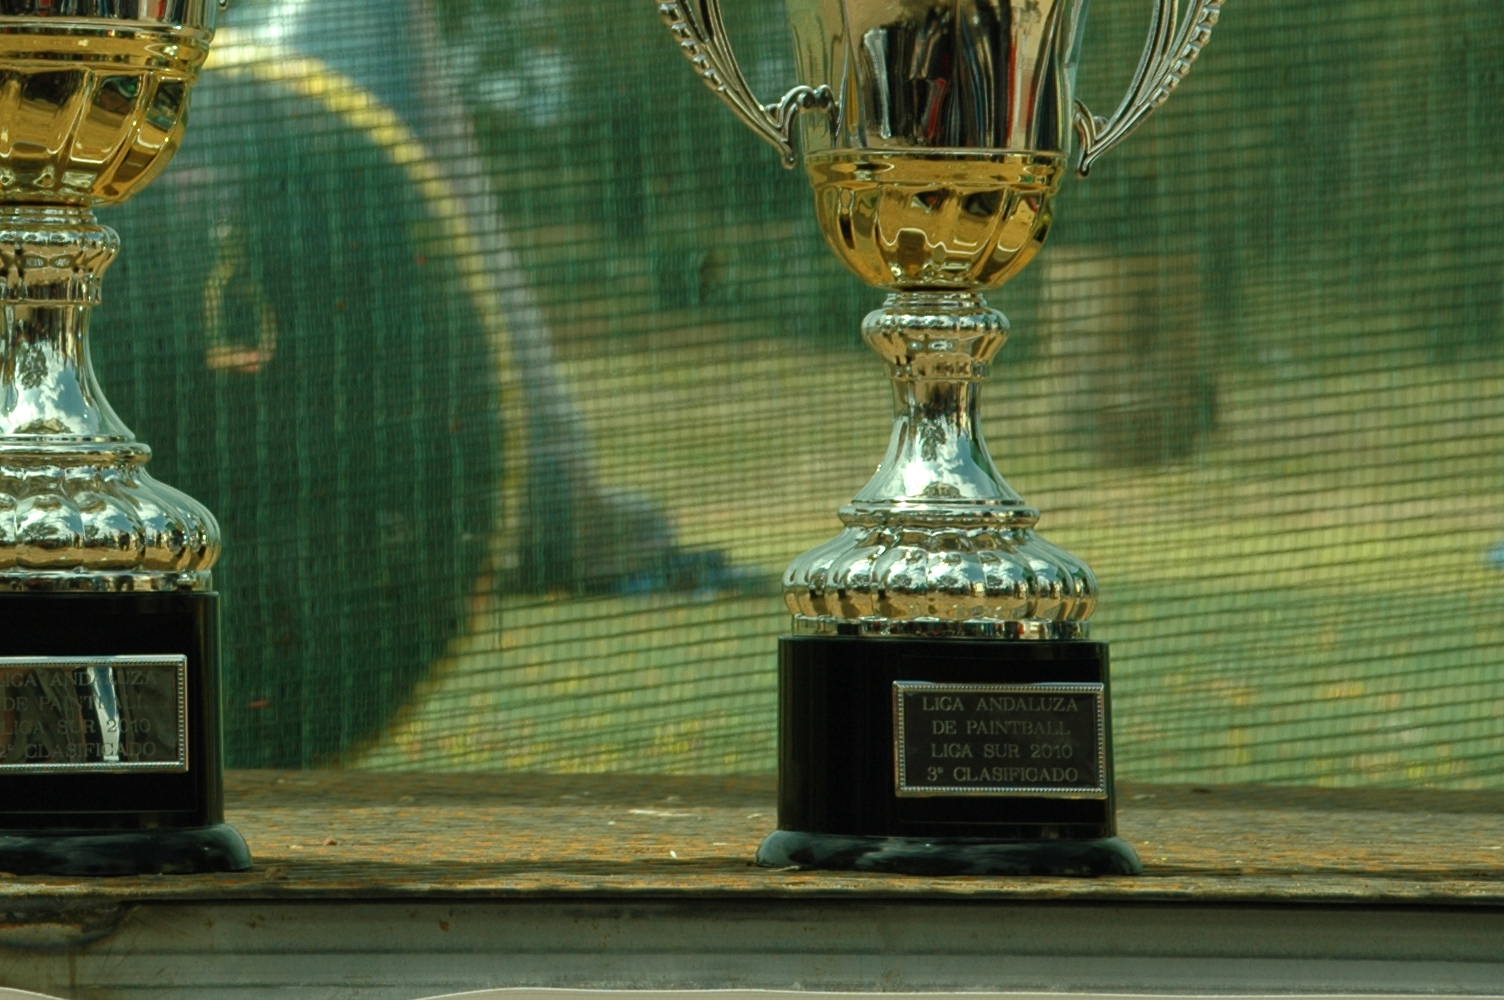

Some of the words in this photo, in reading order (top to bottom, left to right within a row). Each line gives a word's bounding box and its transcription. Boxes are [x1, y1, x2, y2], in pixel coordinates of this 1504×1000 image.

[2, 696, 29, 712] DE
[922, 697, 965, 712] LIGA
[976, 697, 1079, 712] ANDALUZA
[57, 719, 96, 735] SUR
[106, 718, 152, 734] 2010
[932, 720, 957, 735] DE
[966, 720, 1072, 736] PAINTBALL
[930, 743, 974, 759] LIGA
[983, 743, 1022, 758] SUR
[1030, 743, 1074, 758] 2010
[952, 767, 1079, 782] CLASIFICADO
